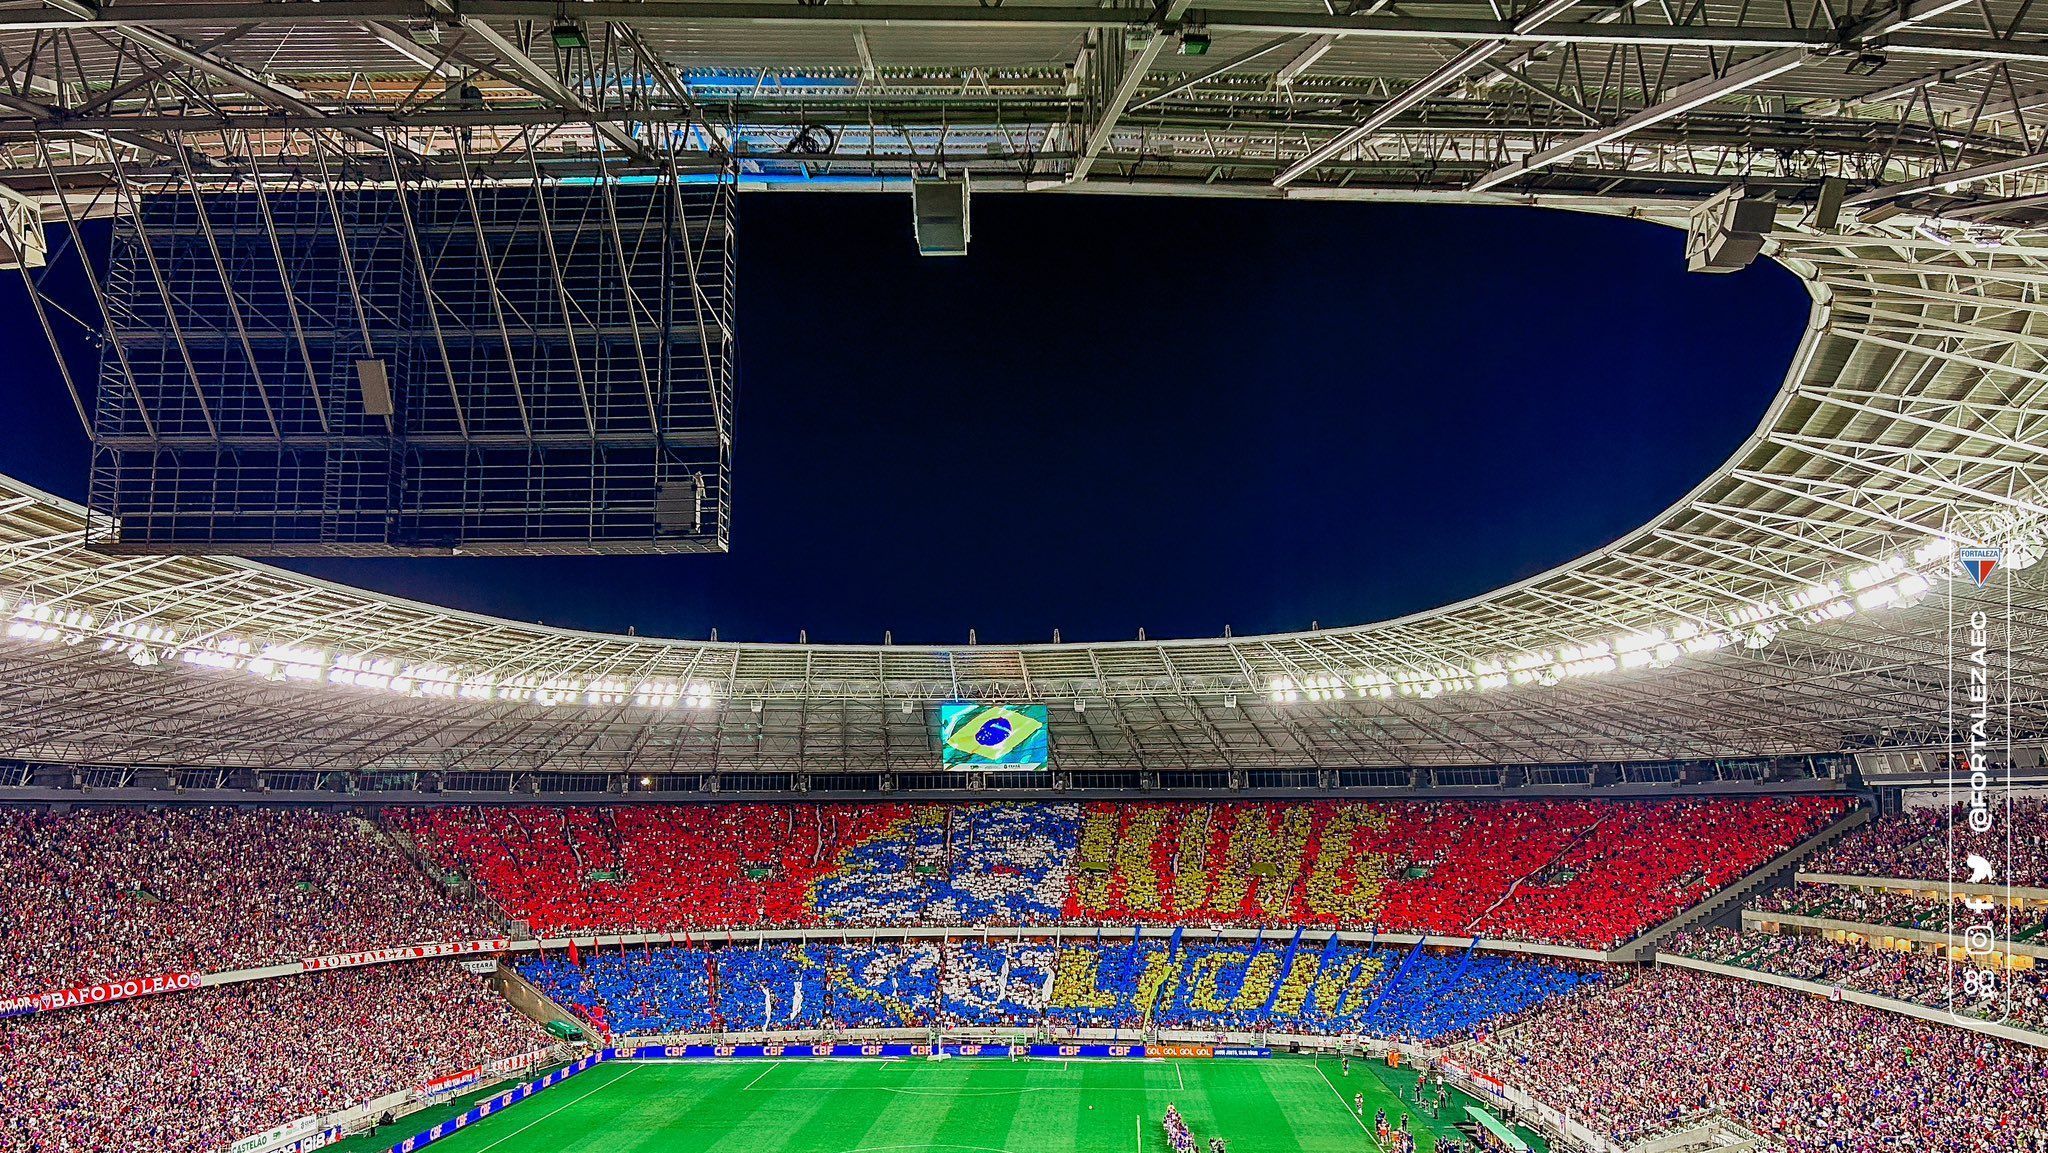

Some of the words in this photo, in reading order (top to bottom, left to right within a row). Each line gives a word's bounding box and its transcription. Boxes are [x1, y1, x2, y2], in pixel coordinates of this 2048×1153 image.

[319, 948, 419, 967] FORTALEZA
[51, 987, 106, 1008] BAFO
[109, 981, 138, 999] DO
[614, 1048, 637, 1058] CBF
[664, 1046, 687, 1057] CBF
[714, 1046, 736, 1057] CBF
[762, 1046, 785, 1056] CBF
[812, 1046, 834, 1056] CBF
[861, 1045, 883, 1055] CBF
[959, 1045, 982, 1055] CBF
[1058, 1046, 1081, 1056] CBF
[1108, 1046, 1131, 1056] CBF
[1146, 1047, 1161, 1055] GOL
[1180, 1048, 1194, 1056] GOL
[1196, 1048, 1211, 1056] GOL
[402, 1135, 415, 1151] CBF
[429, 1124, 443, 1141] CBF
[456, 1112, 468, 1128] CBF
[479, 1101, 491, 1117] CBF
[502, 1092, 513, 1107] CBF
[523, 1083, 533, 1097] CBF
[542, 1074, 552, 1088] CBF
[561, 1066, 570, 1079] CBF
